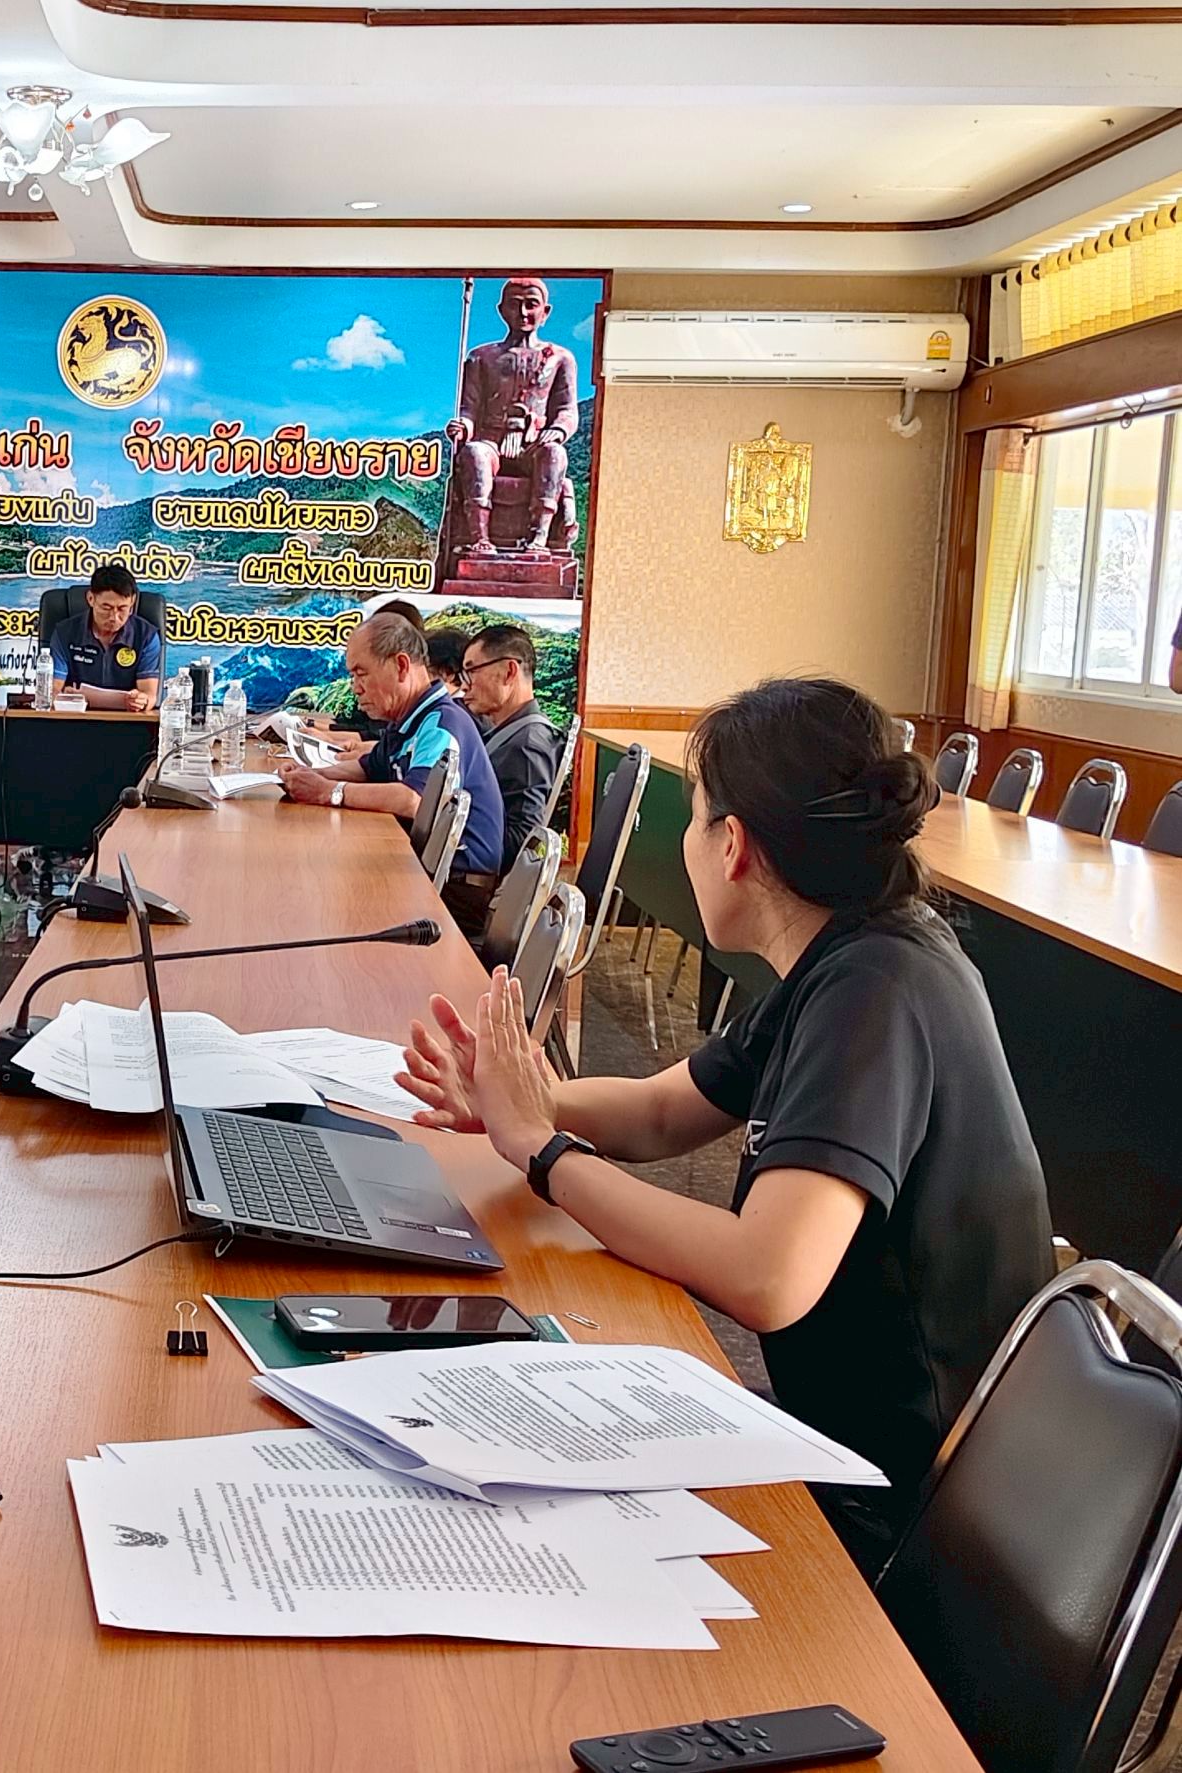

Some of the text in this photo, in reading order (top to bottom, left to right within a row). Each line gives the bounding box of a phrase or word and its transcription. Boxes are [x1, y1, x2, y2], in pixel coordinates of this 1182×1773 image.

[125, 421, 440, 477] จังหวัดเชียงราย
[157, 492, 374, 531] ชายแดนไทยลาว
[242, 539, 431, 589] ผาตั้งเด่นนาน
